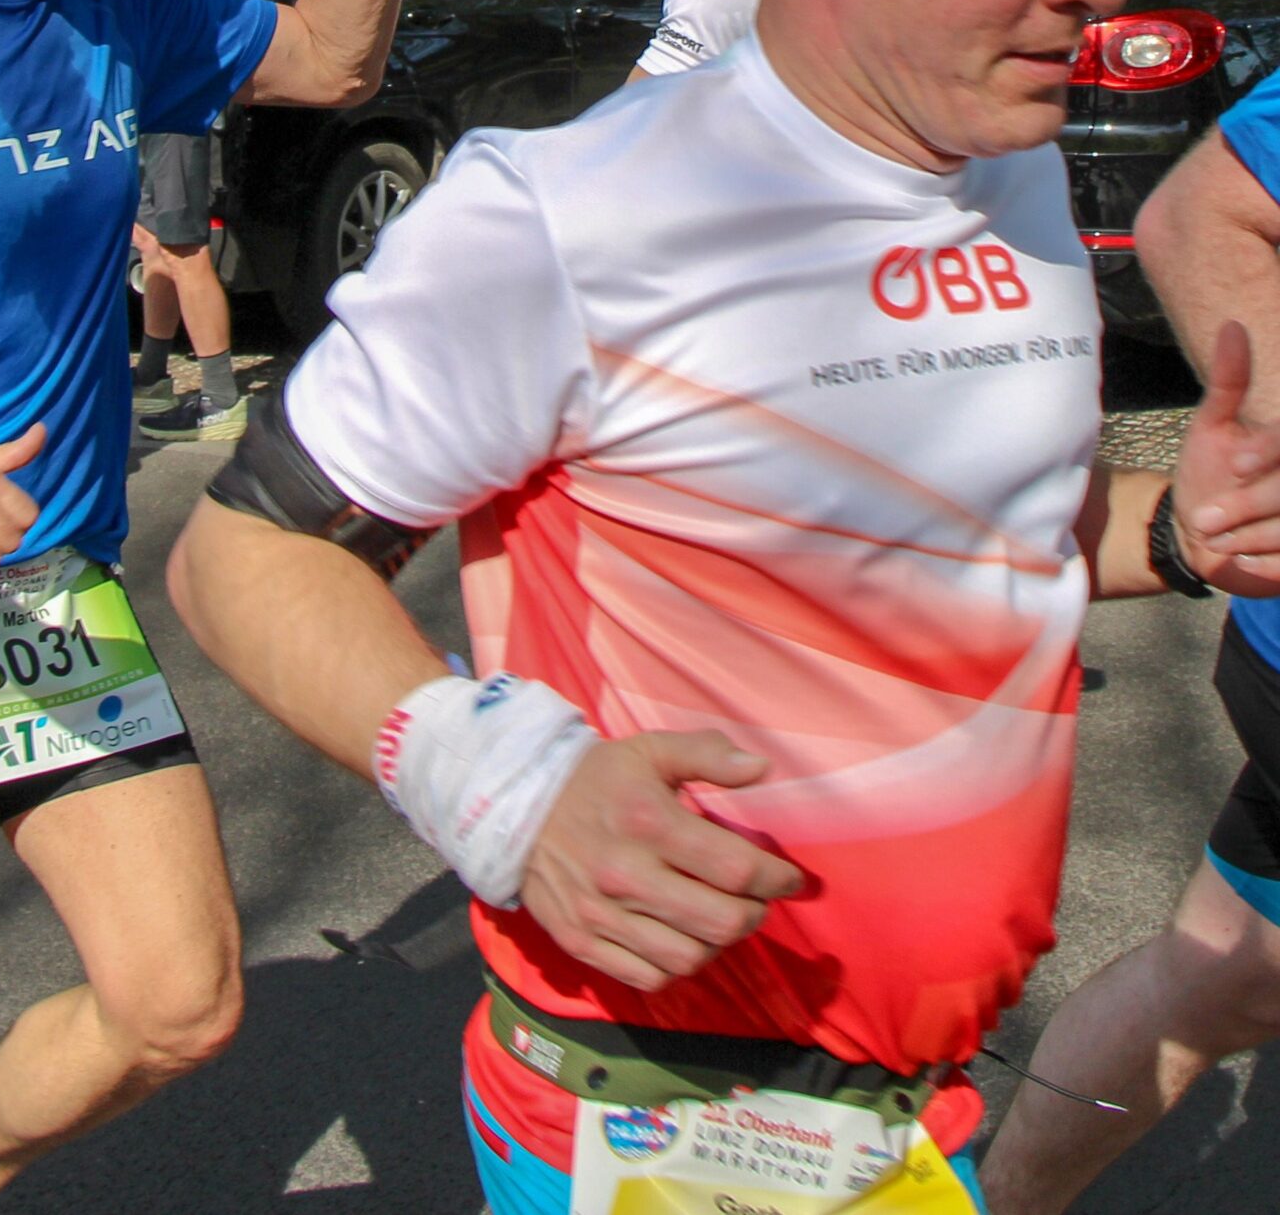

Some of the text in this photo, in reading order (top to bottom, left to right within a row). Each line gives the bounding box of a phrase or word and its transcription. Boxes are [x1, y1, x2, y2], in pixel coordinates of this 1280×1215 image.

[84, 108, 138, 161] AG
[809, 356, 894, 388] HEUTE.
[896, 347, 939, 377] FÜR
[1026, 334, 1064, 363] FÜR
[3, 607, 50, 628] Martin
[46, 668, 145, 706] HALBMARATHON
[46, 714, 152, 758] Nitrogen
[690, 1140, 828, 1190] MARATHON
[752, 1135, 833, 1171] DONAU
